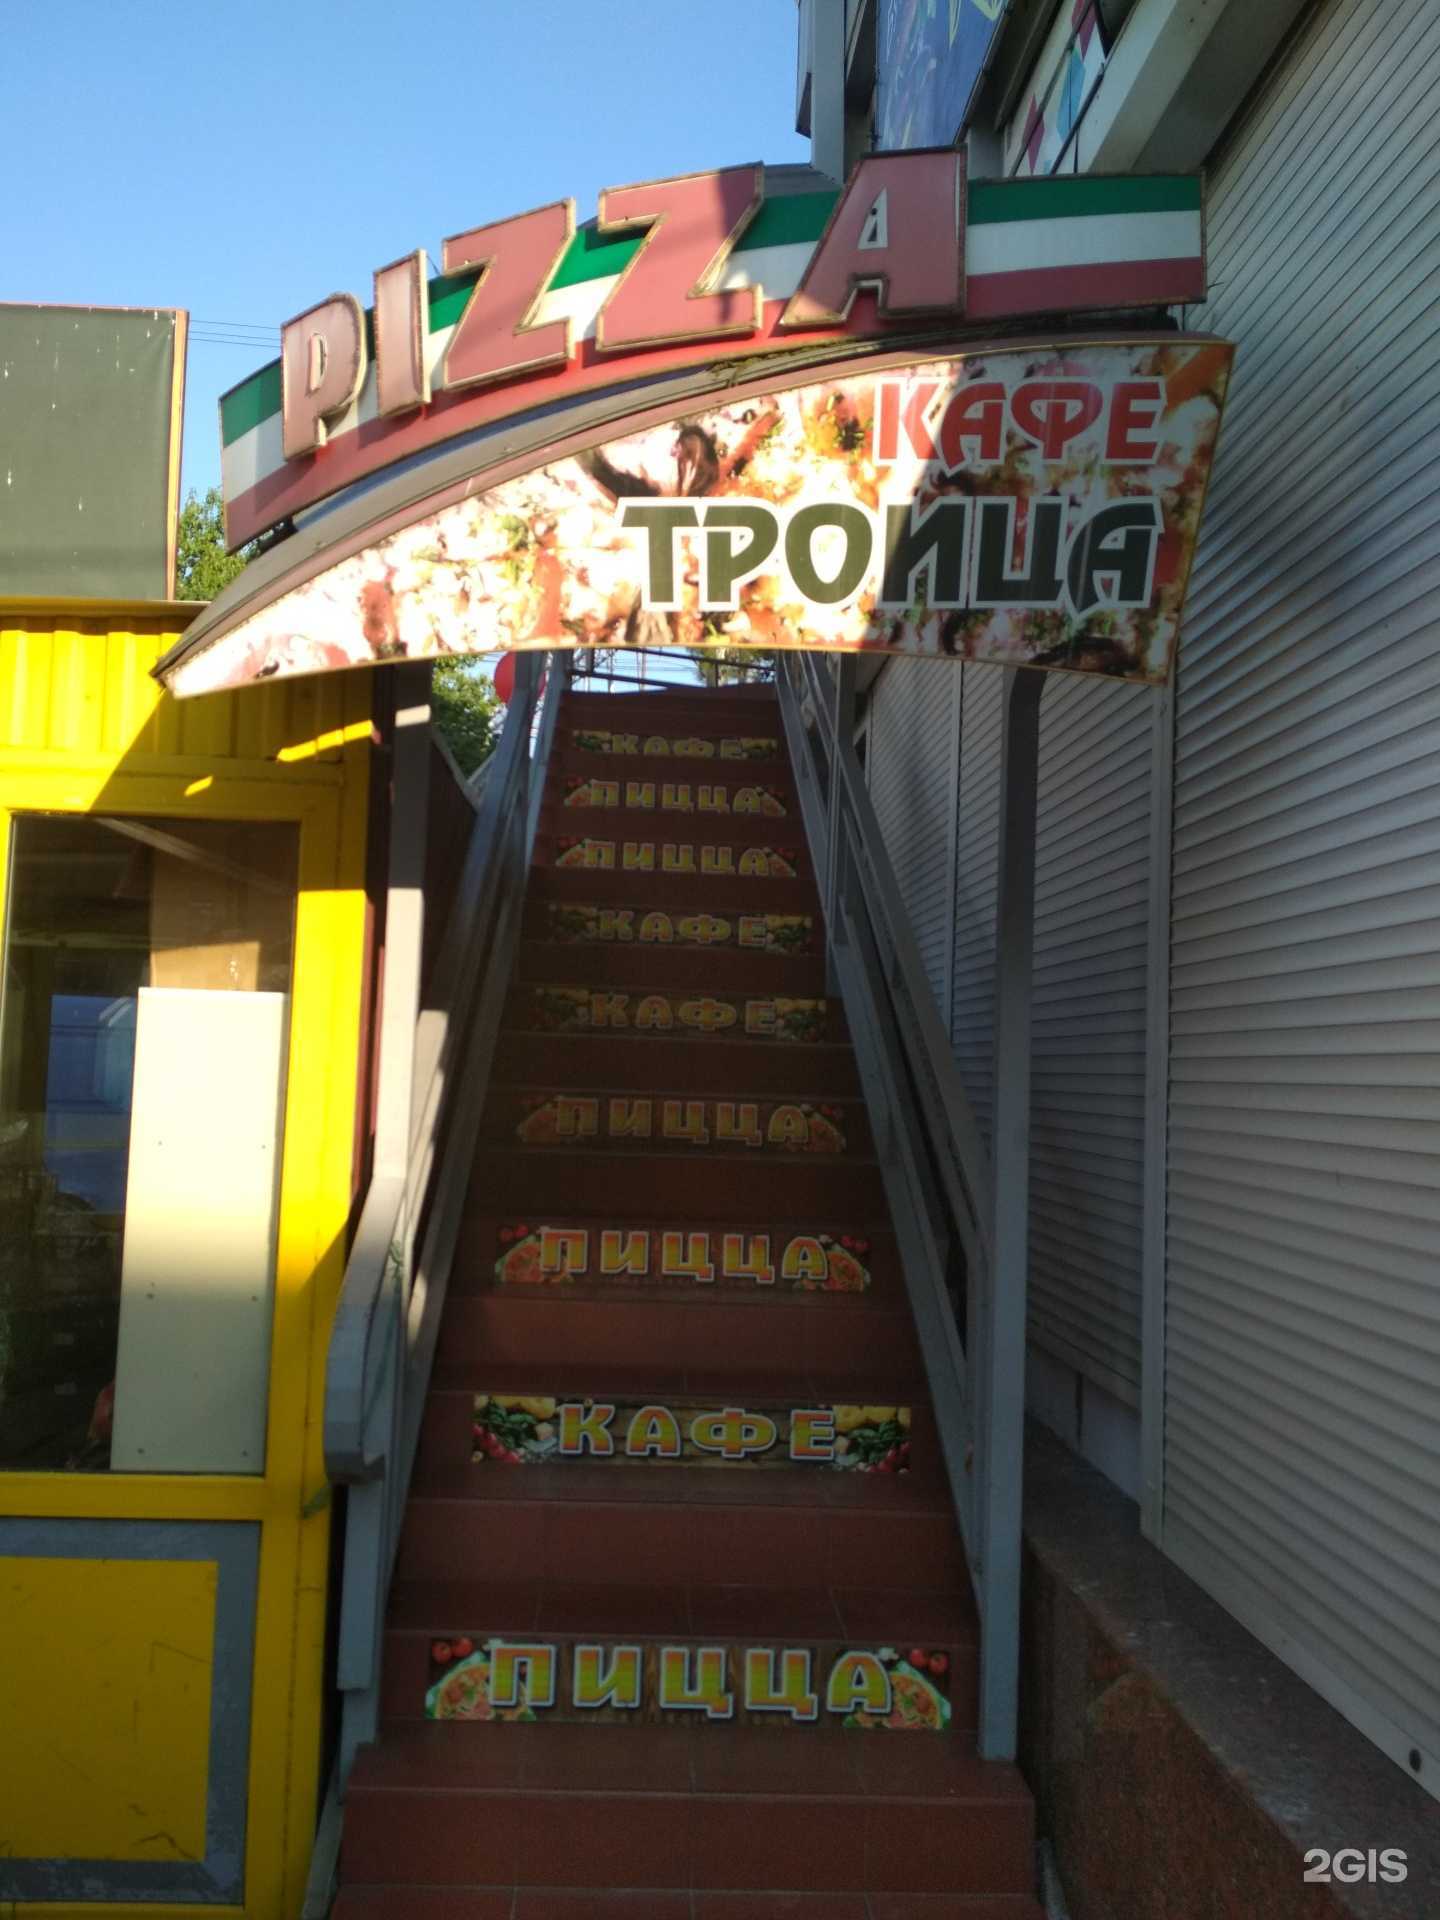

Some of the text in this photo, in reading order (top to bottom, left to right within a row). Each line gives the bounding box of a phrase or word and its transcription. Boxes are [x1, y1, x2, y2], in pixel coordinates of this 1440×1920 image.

[280, 146, 967, 460] PIZZA
[875, 376, 1171, 472] КАФЕ
[618, 496, 1166, 617] ТРОИЦА
[610, 733, 748, 760] КАФЕ
[588, 780, 762, 813] ПИЦЦА
[584, 840, 770, 876] ПИЦЦА
[600, 909, 769, 946] КАФЕ
[591, 994, 778, 1034] КАФЕ
[555, 1099, 810, 1146] ПИЦЦА
[539, 1228, 829, 1285] ПИЦЦА
[558, 1403, 836, 1460] КАФЕ
[488, 1643, 893, 1721] ПИЦЦА
